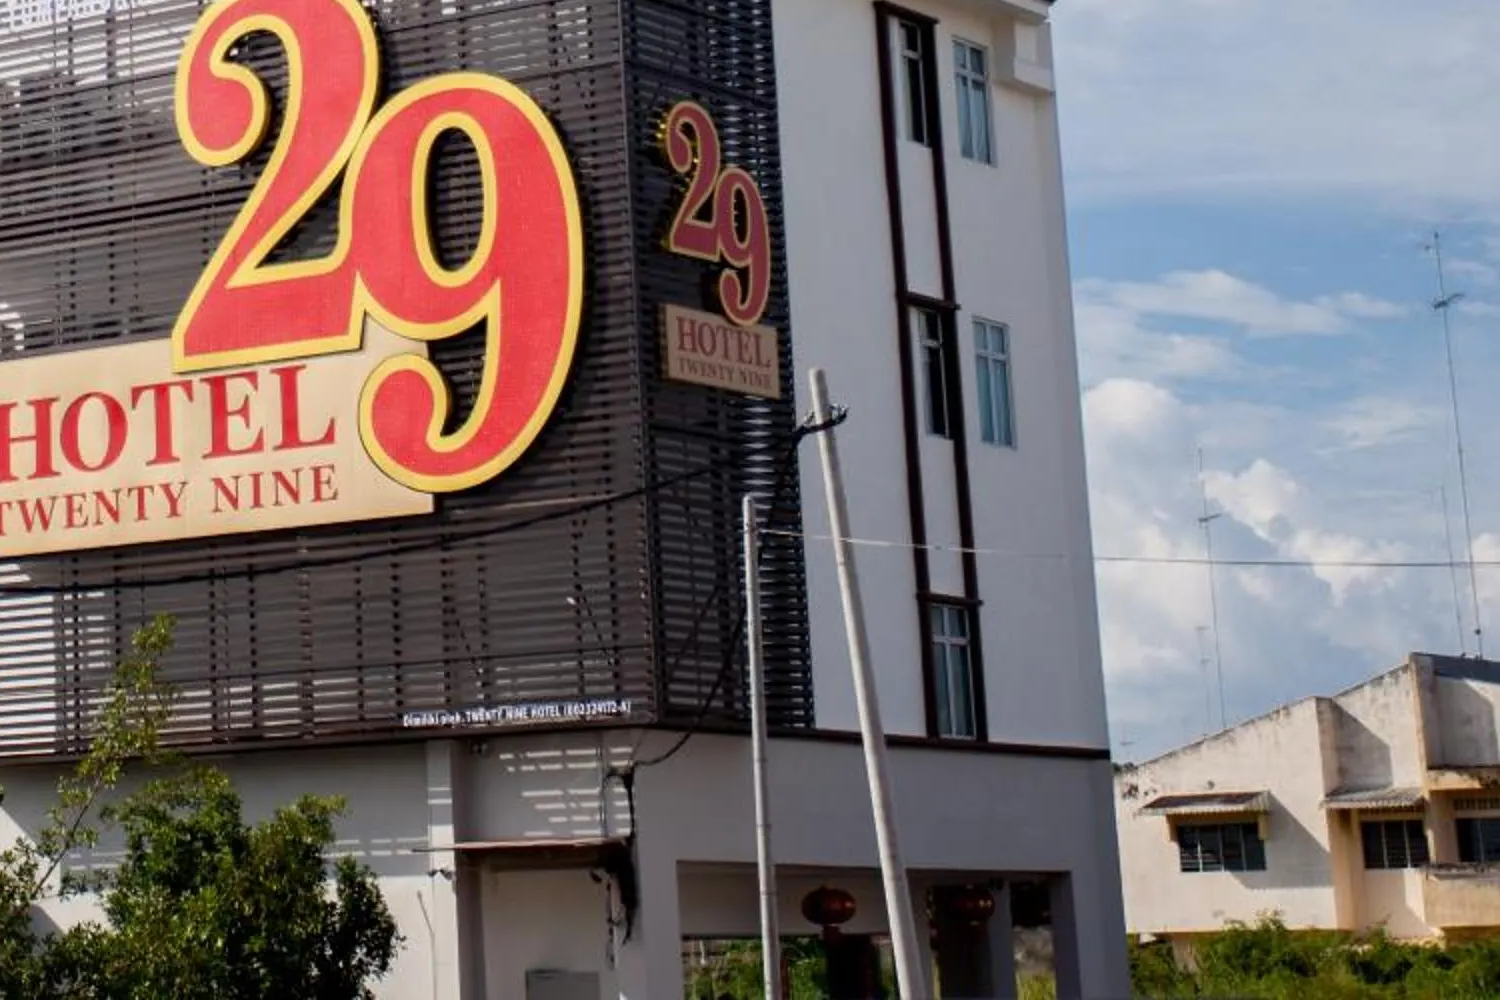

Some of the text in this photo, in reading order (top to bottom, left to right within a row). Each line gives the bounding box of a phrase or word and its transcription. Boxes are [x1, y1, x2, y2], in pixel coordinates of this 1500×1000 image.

[665, 100, 771, 326] 29
[676, 314, 772, 368] HOTEL
[680, 357, 773, 390] TWENTY NINE
[211, 463, 339, 514] NINE
[465, 706, 502, 723] TWENTY
[505, 704, 529, 720] NINE
[531, 702, 561, 718] HOTEL
